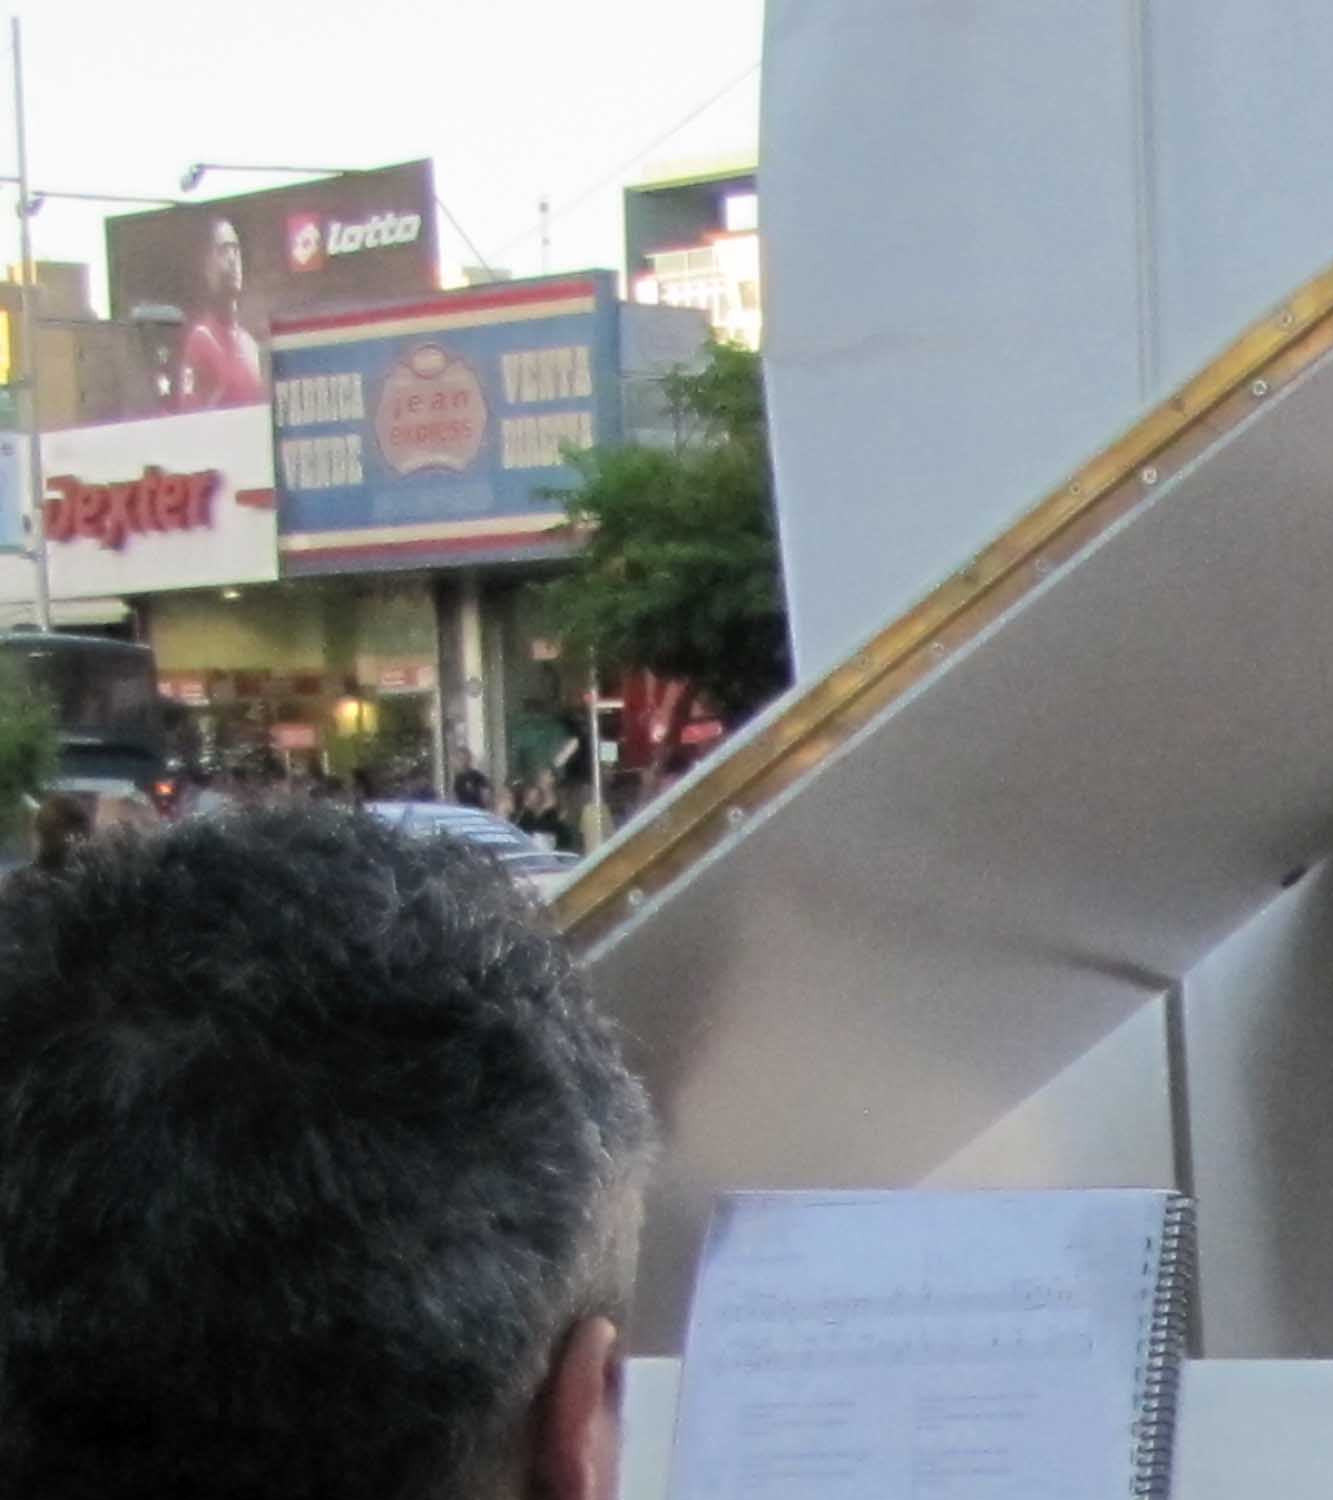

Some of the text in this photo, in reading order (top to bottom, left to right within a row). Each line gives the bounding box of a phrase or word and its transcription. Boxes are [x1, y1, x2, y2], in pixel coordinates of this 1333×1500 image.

[328, 212, 421, 255] lotto
[392, 387, 470, 421] jean
[44, 465, 221, 553] Dexter
